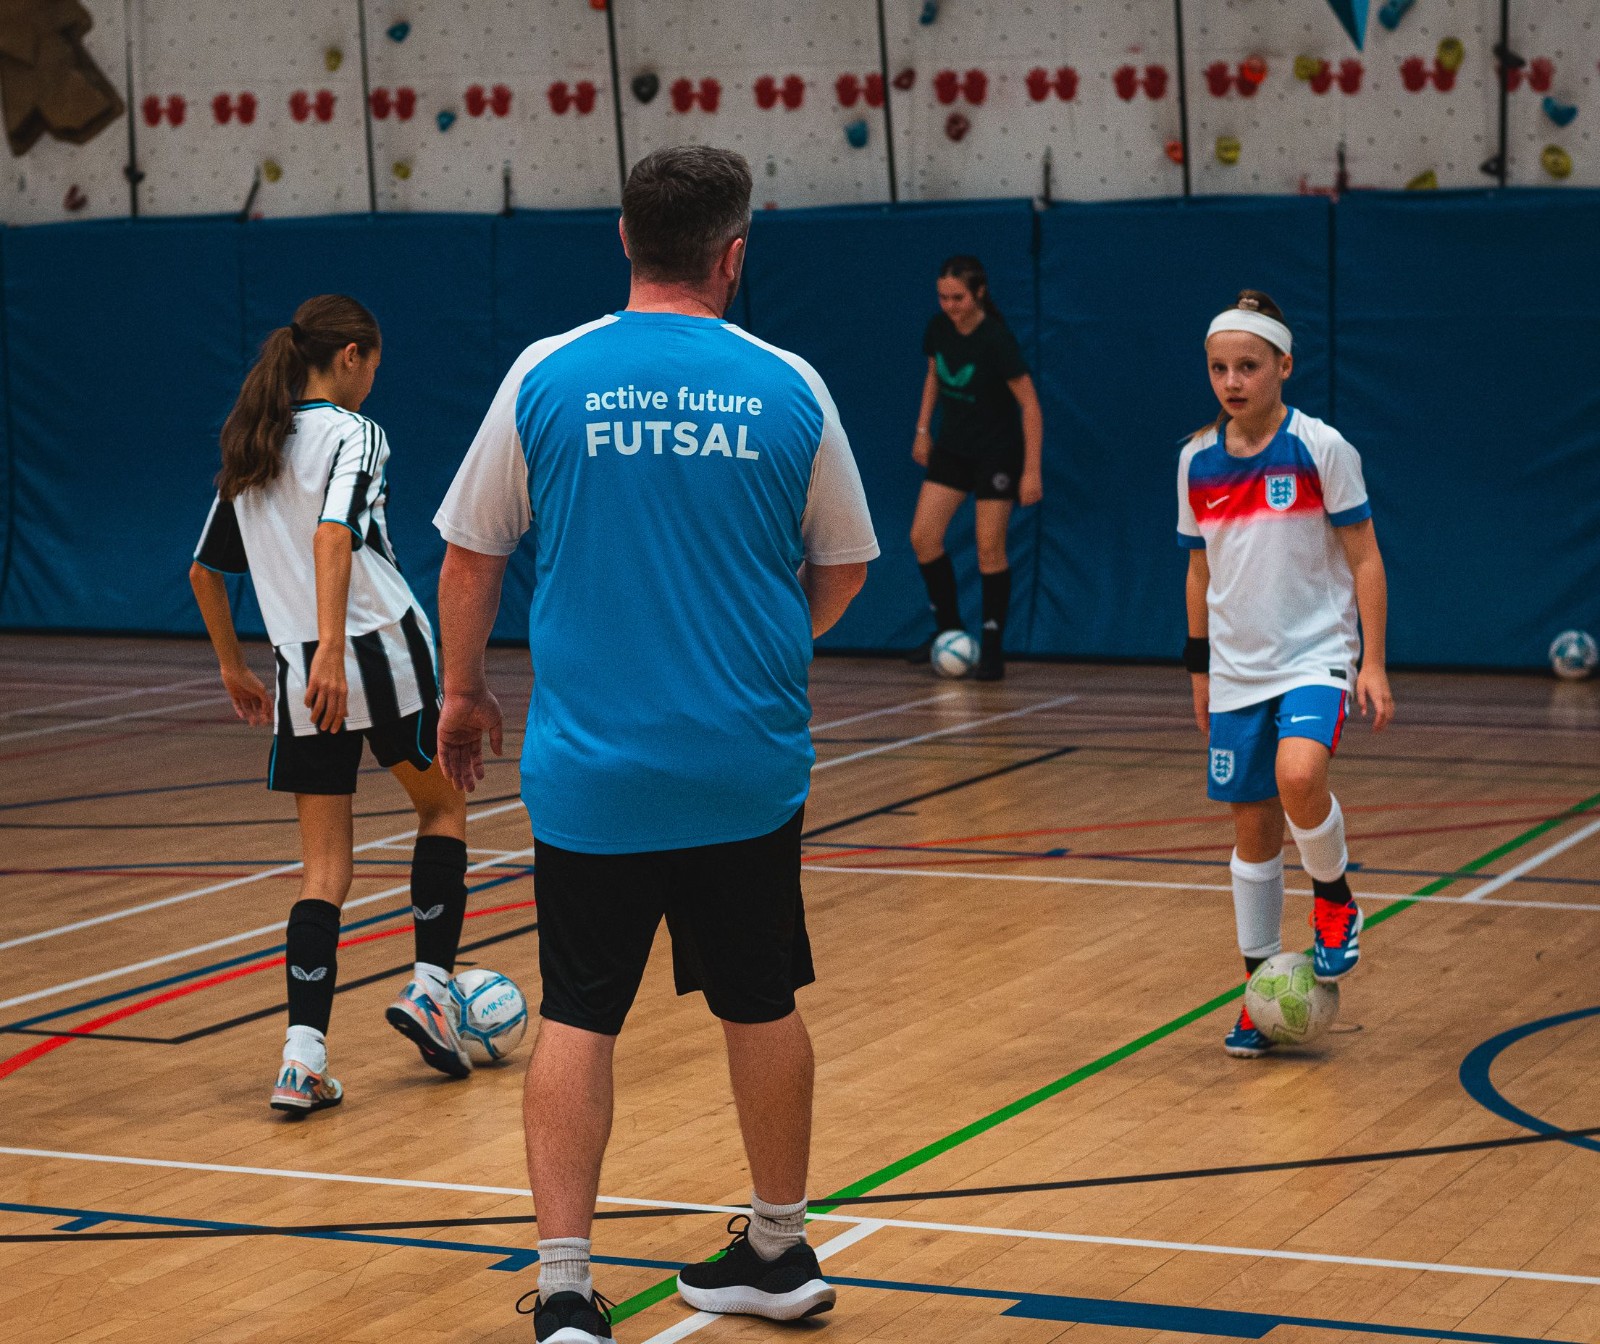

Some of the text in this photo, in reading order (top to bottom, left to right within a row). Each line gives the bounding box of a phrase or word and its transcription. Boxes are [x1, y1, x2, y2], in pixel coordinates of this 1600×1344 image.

[585, 385, 763, 415] active future
[585, 421, 760, 460] FUTSAL
